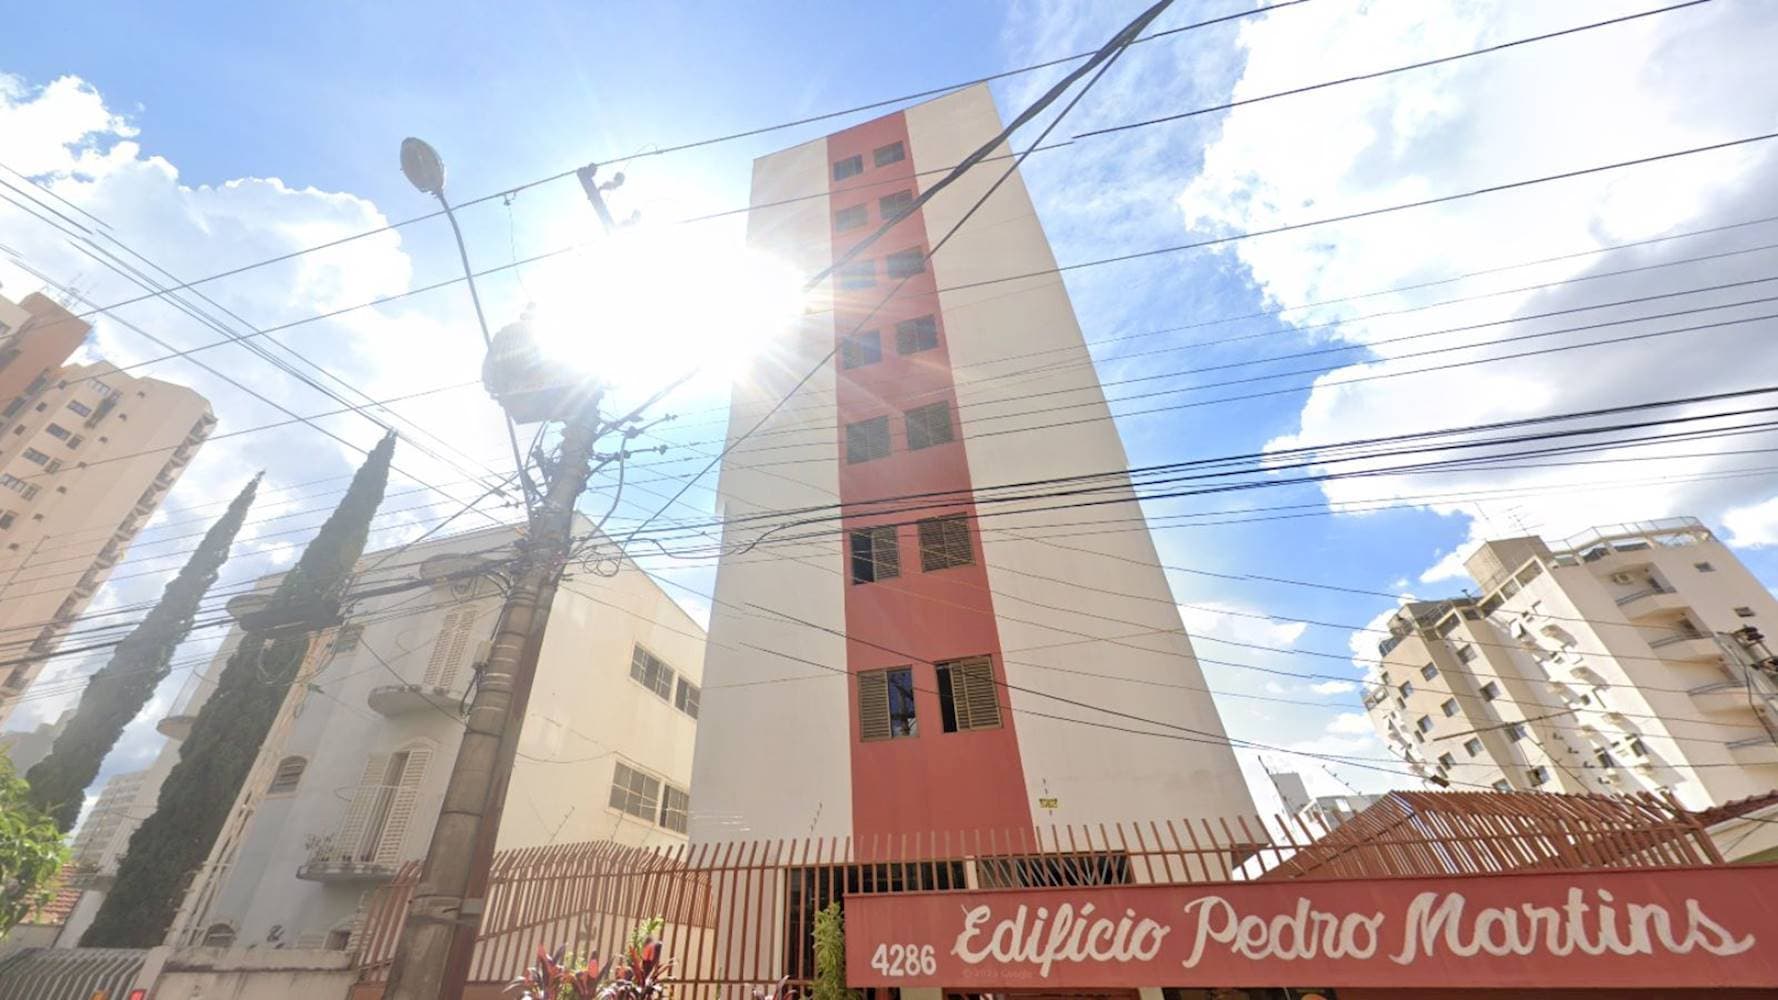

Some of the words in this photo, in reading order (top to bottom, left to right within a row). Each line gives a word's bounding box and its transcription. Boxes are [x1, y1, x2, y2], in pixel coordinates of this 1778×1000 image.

[871, 943, 937, 977] 4286
[951, 903, 1171, 978] Edifício
[1182, 896, 1385, 968] Pedro
[1389, 887, 1755, 965] Martins
